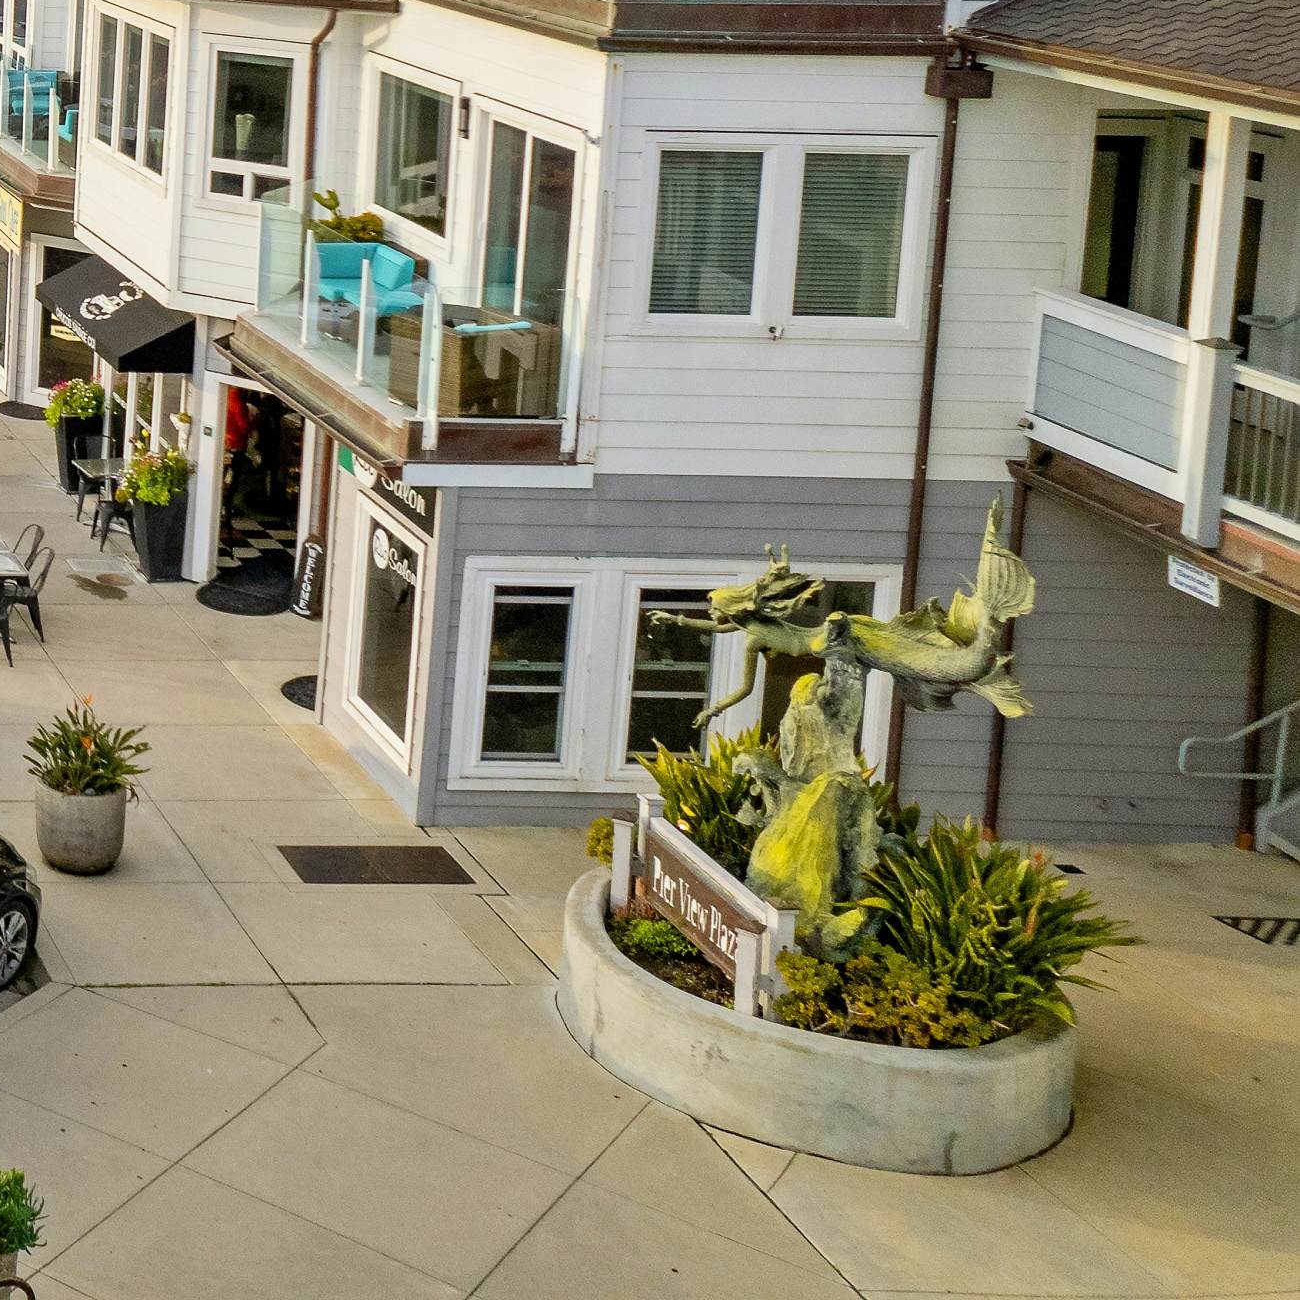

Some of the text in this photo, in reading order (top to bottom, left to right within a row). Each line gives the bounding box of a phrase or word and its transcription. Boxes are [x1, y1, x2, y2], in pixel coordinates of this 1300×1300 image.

[298, 546, 318, 610] WELCOME
[388, 547, 417, 587] Salon
[652, 855, 738, 963] Pier View Plaz
